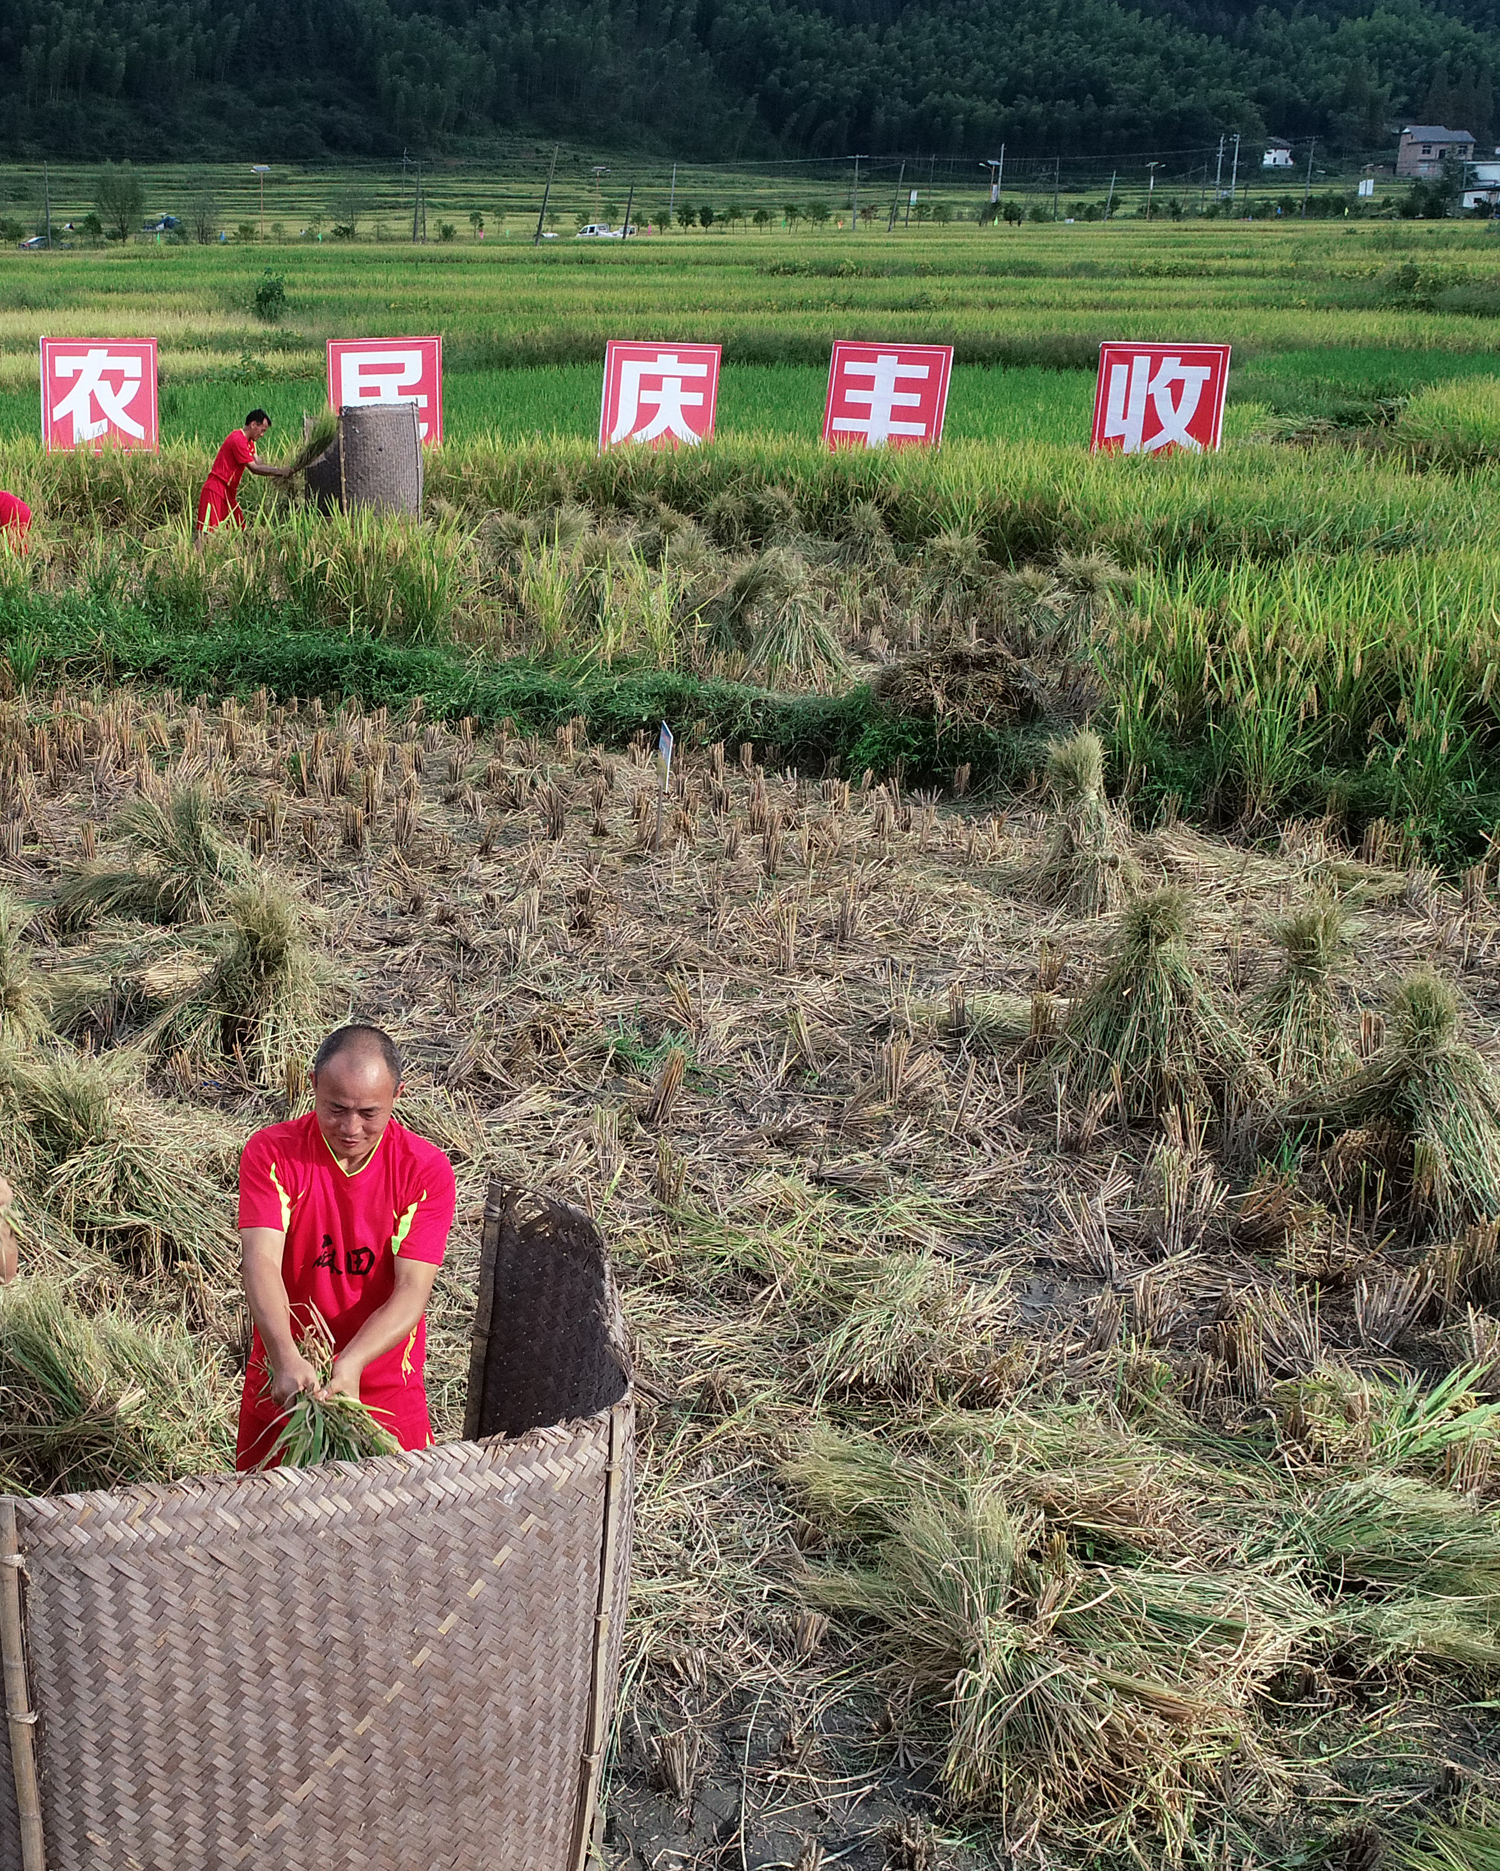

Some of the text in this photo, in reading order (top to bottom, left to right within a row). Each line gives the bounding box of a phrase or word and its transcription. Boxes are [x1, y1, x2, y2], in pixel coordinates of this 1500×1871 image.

[52, 349, 146, 446] 农
[610, 354, 709, 446] 庆
[832, 355, 930, 450] 丰
[1104, 356, 1212, 455] 收
